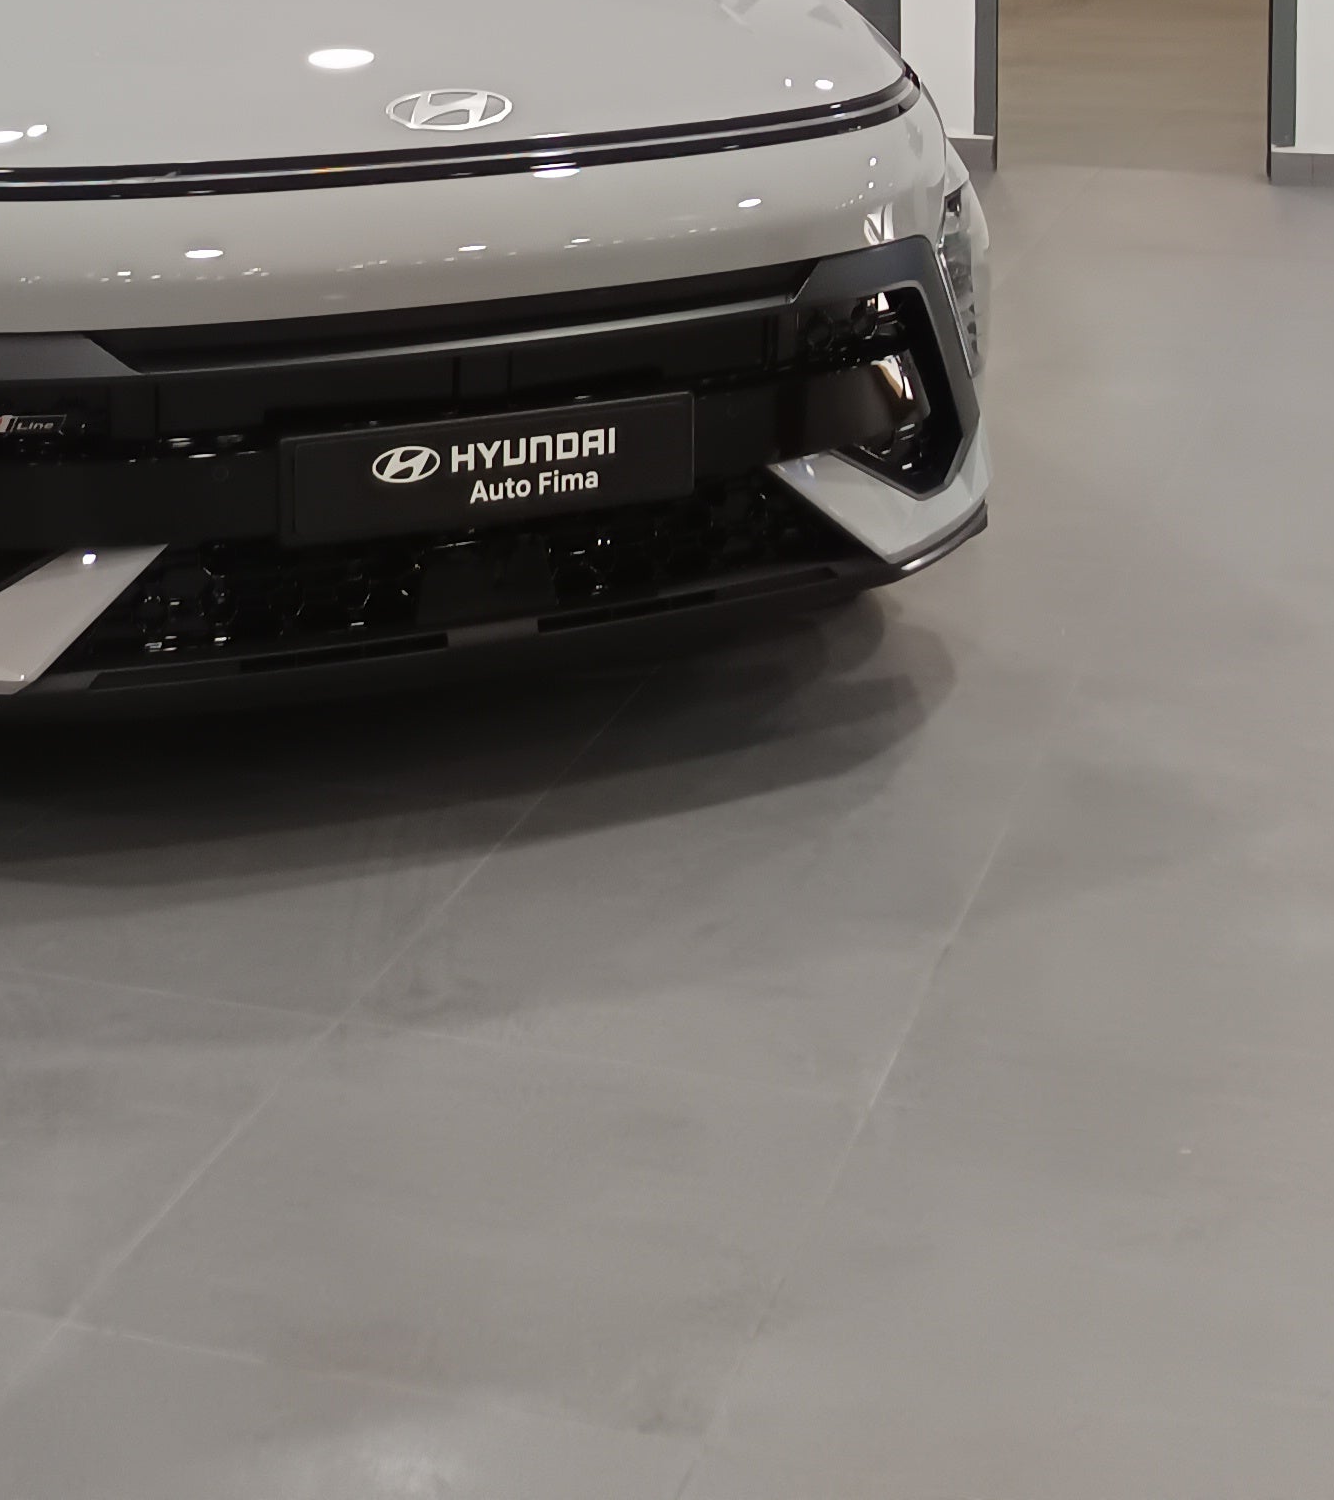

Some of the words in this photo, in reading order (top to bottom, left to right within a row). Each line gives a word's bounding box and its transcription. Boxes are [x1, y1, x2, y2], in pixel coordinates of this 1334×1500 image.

[451, 427, 616, 473] HYUNDAI
[470, 480, 531, 504] Auto
[538, 469, 599, 495] Fima
